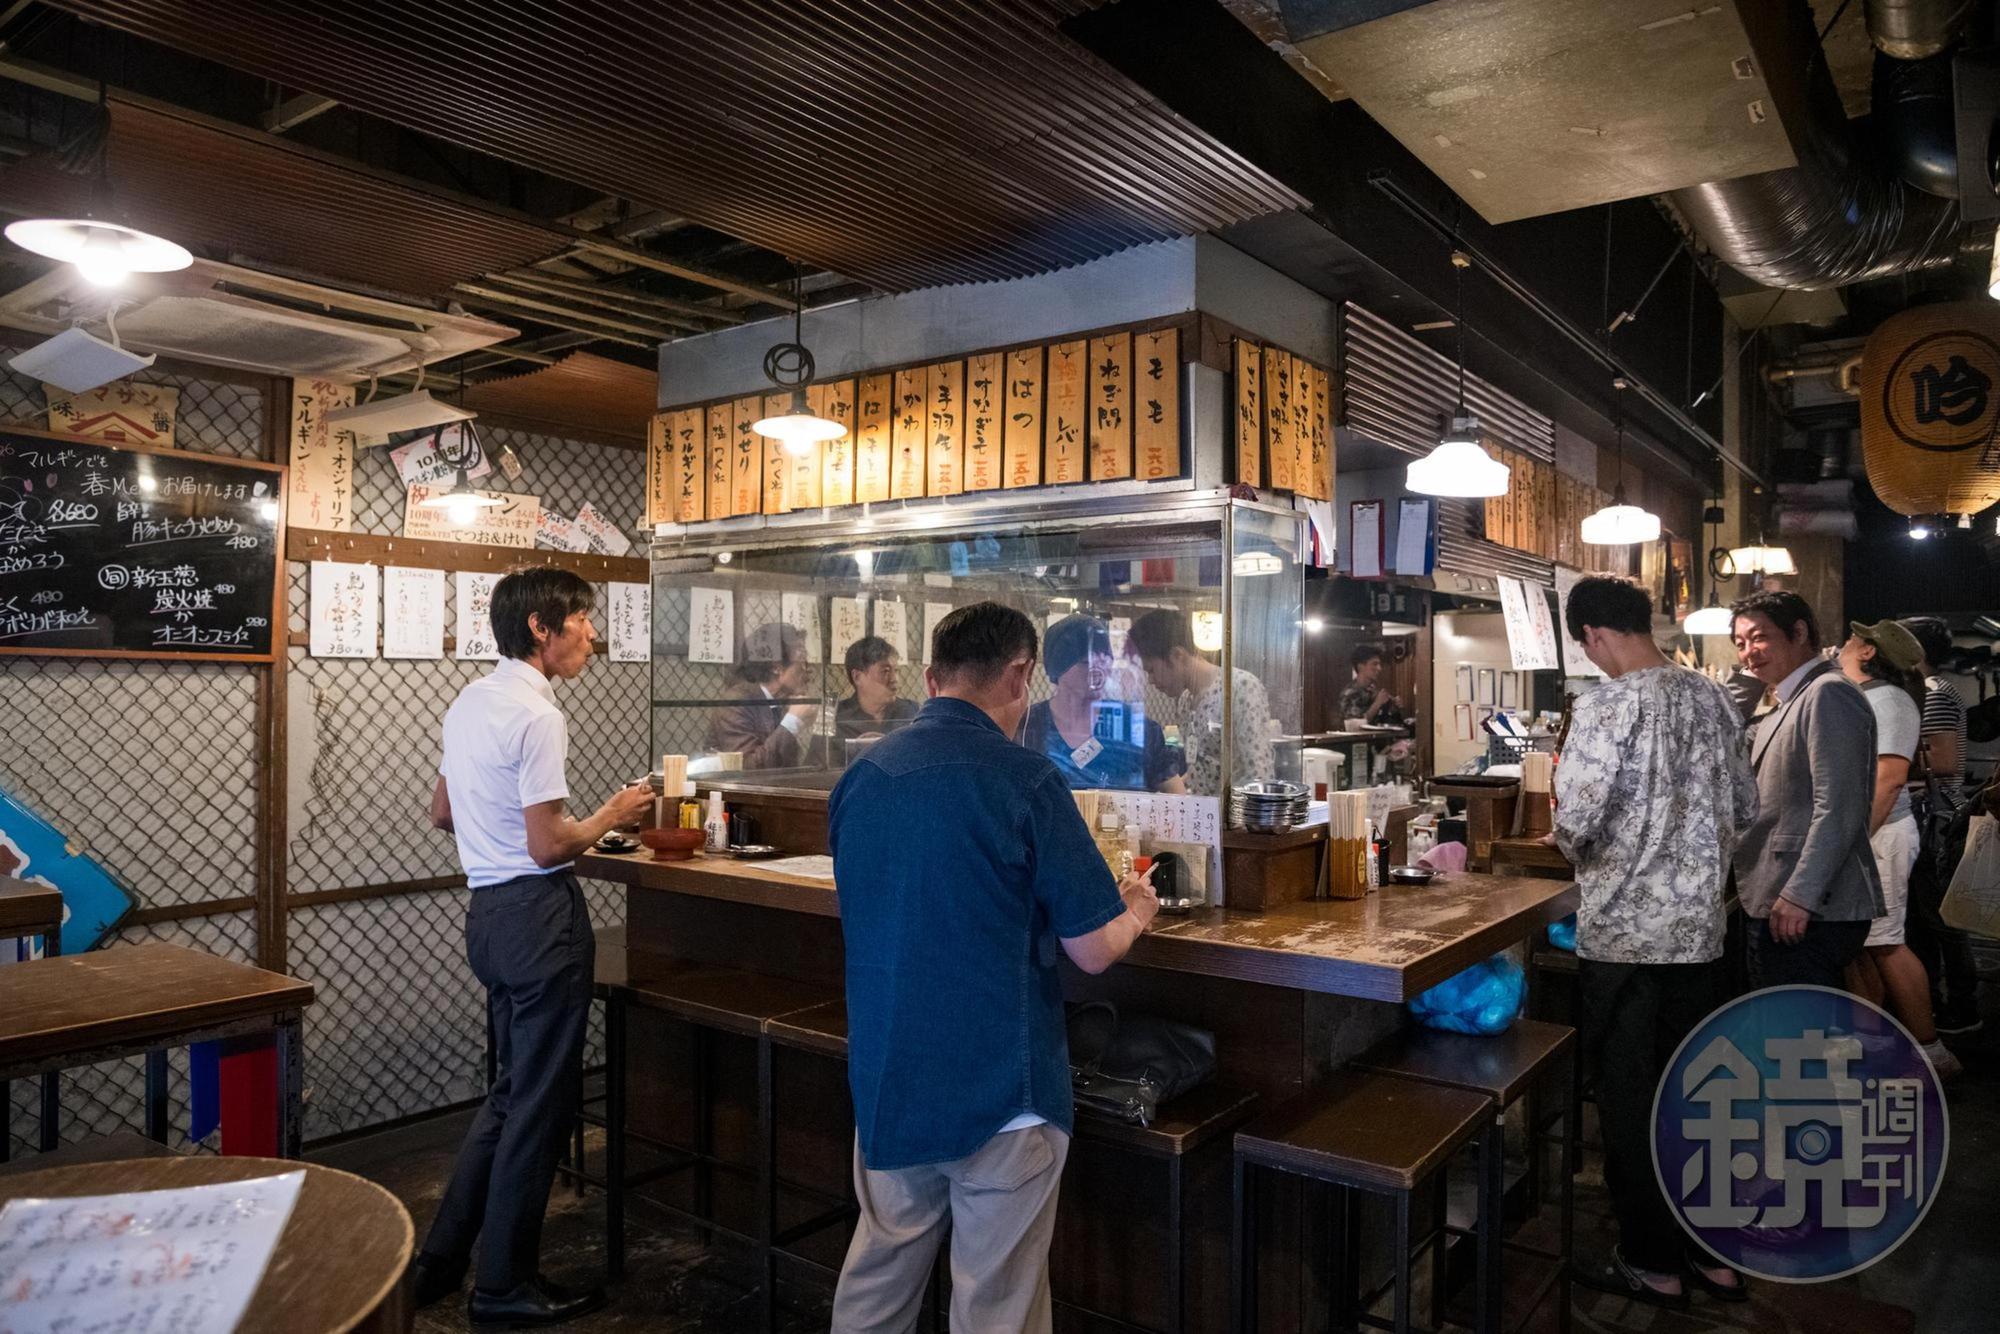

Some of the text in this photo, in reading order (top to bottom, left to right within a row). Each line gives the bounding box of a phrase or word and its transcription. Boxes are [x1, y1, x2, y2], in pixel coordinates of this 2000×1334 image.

[1012, 379, 1035, 429] はつ
[1098, 358, 1122, 430] ねぎ間
[1147, 357, 1164, 425] もも
[903, 393, 922, 432] かわ
[932, 384, 954, 452] 手羽先
[972, 378, 993, 455] すなぎも
[737, 419, 753, 475] せせり
[1056, 416, 1079, 455] レバー
[225, 535, 259, 550] 480
[130, 564, 200, 589] 新玉葱
[30, 590, 64, 605] 480
[155, 583, 236, 610] 炭火焼 480
[0, 606, 97, 635] ボカド和え
[174, 610, 195, 624] か
[464, 639, 493, 656] 680
